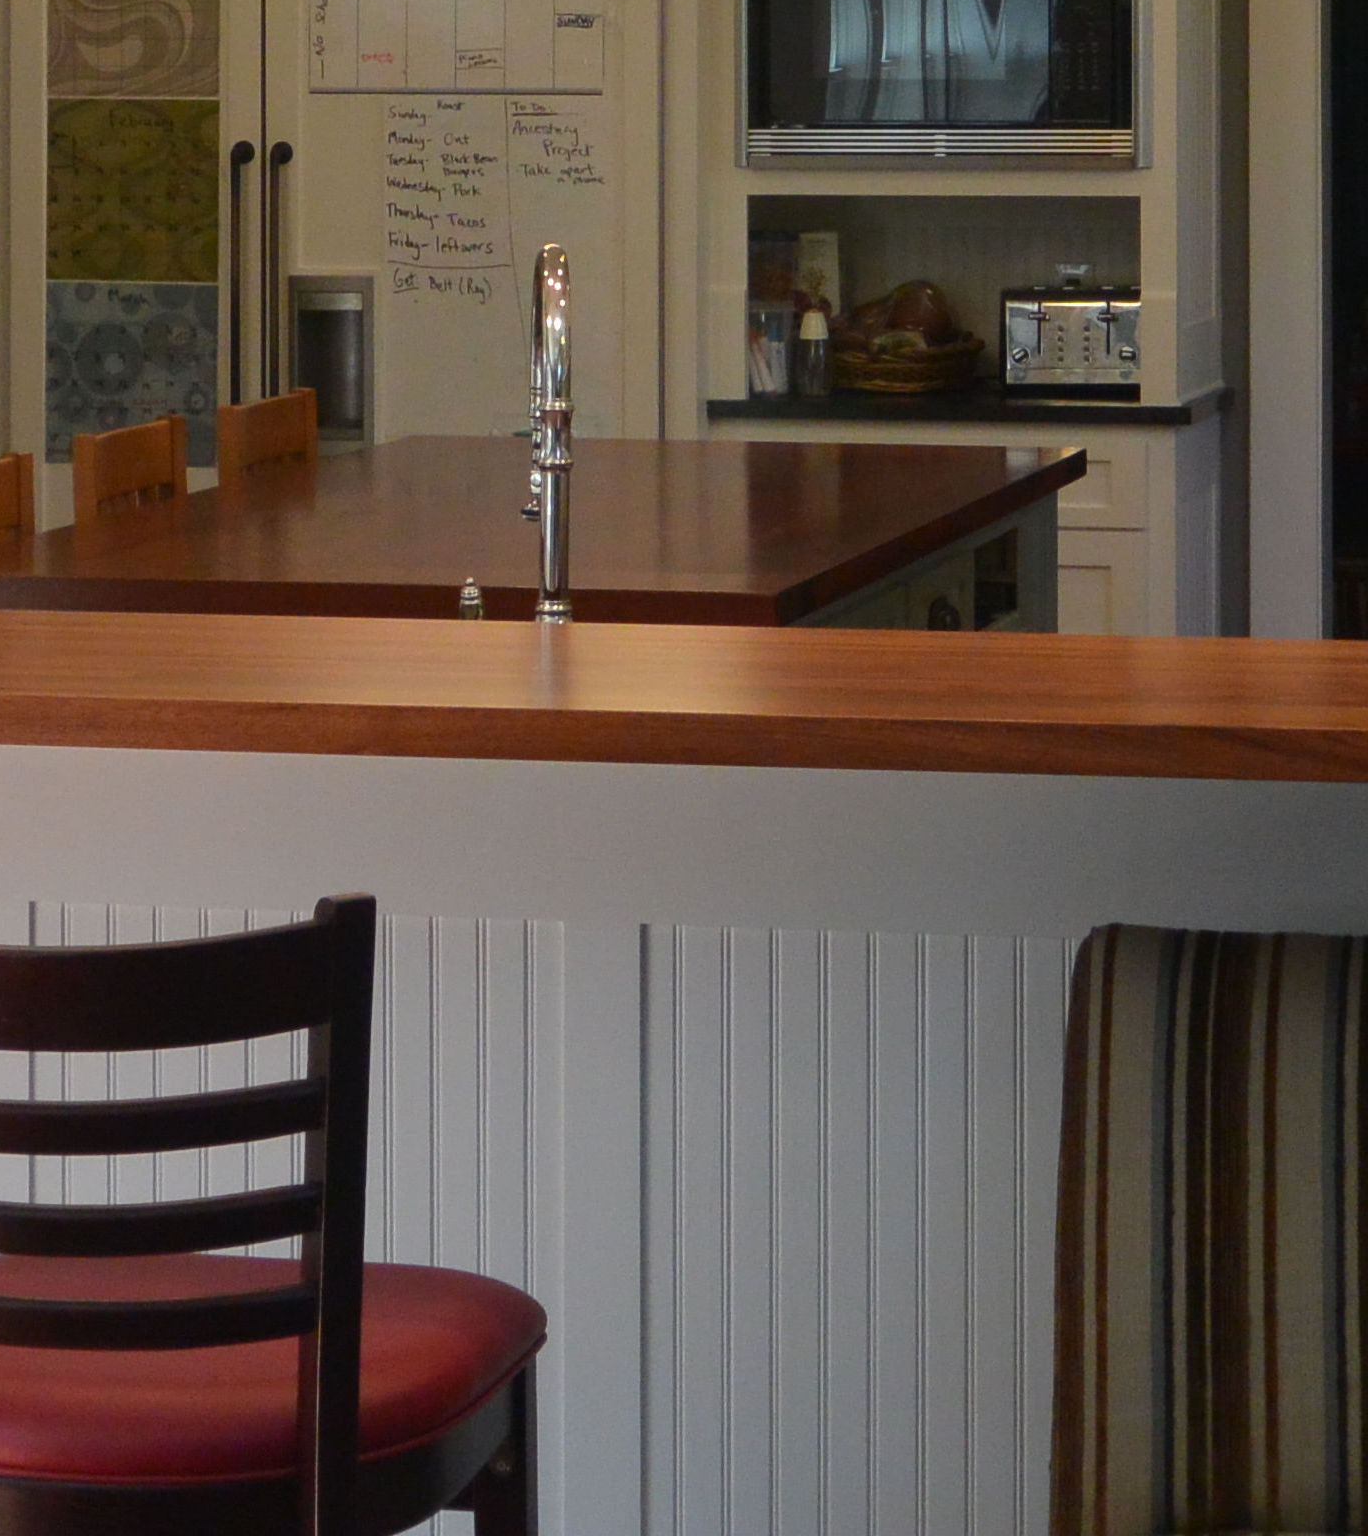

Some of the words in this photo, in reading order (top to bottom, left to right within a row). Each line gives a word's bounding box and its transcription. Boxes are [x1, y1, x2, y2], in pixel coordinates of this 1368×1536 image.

[510, 101, 527, 112] To
[542, 137, 595, 162] Project
[520, 162, 552, 177] Take
[446, 212, 486, 229] Tacos
